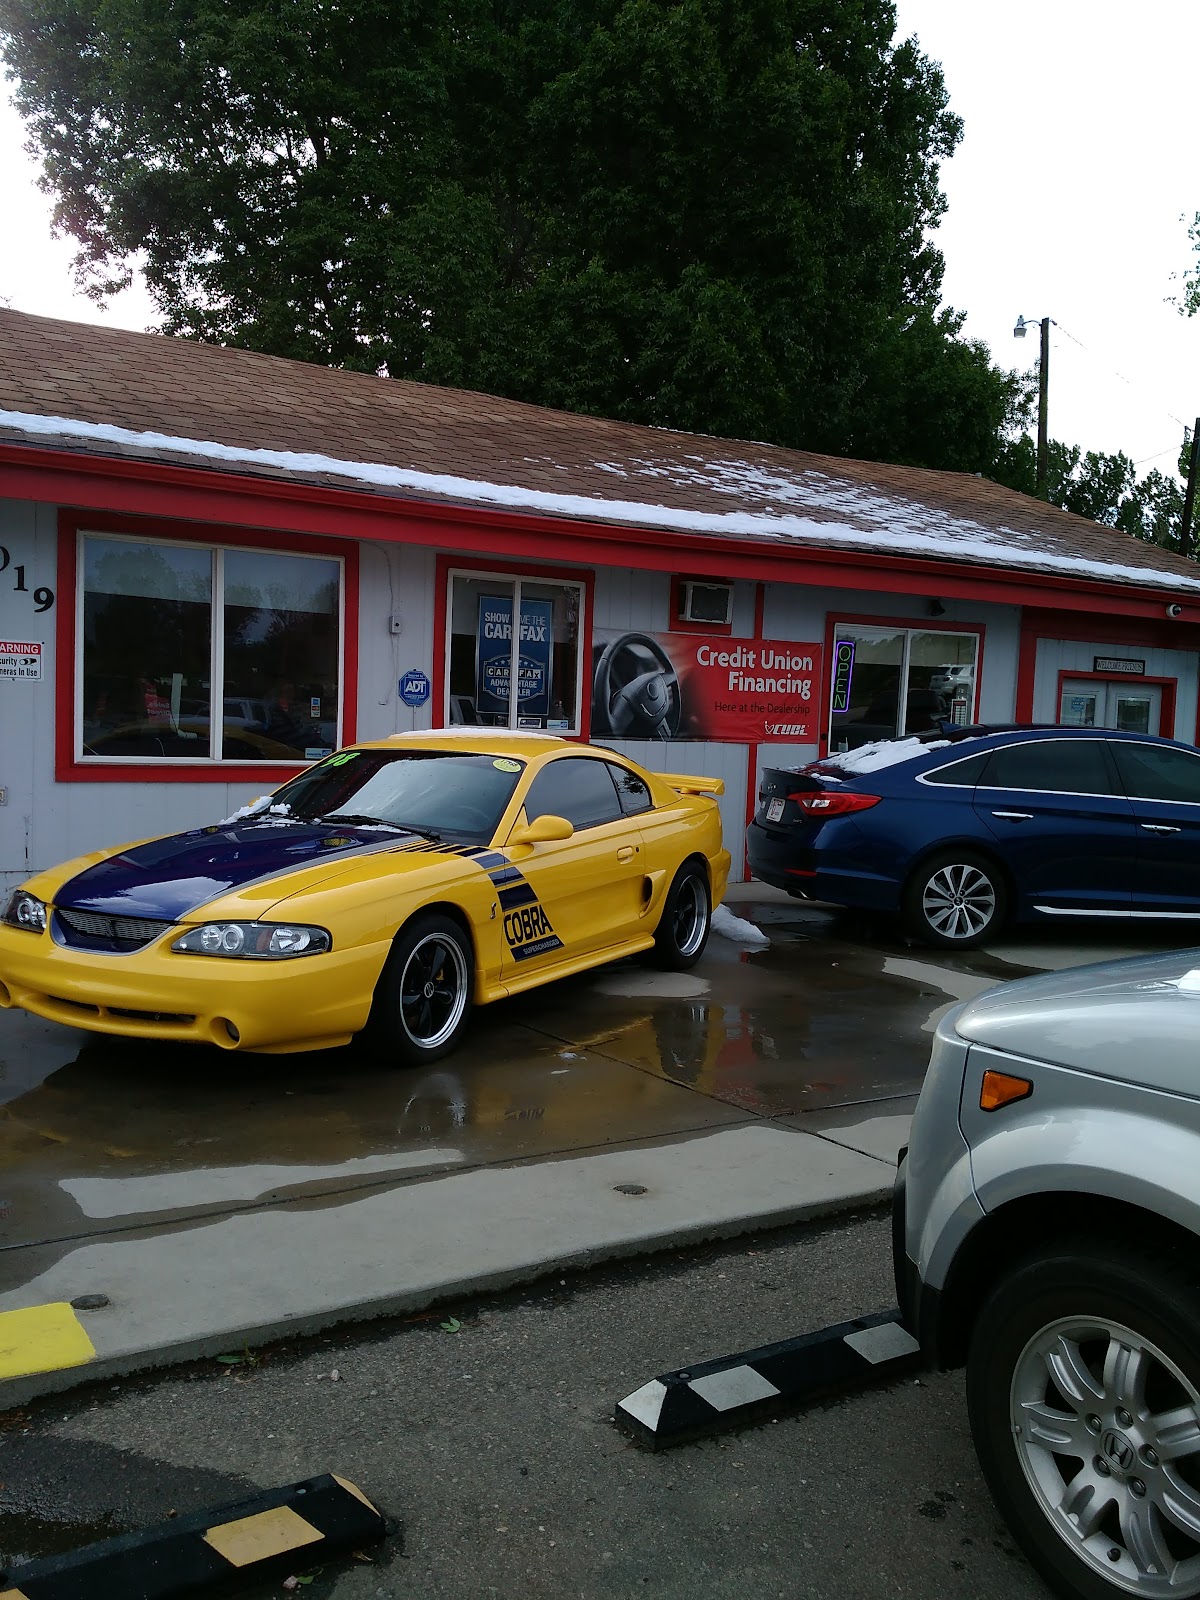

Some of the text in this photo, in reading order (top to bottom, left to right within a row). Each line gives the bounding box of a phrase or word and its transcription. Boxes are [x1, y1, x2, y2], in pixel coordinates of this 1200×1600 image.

[484, 611, 510, 624] SHOW
[531, 615, 546, 627] THE
[0, 643, 39, 654] ARNING
[696, 645, 813, 671] Credit Union
[18, 667, 25, 676] In
[26, 667, 38, 677] Use
[834, 645, 851, 708] OPEN
[405, 680, 427, 693] ADT
[728, 670, 812, 700] Financing
[714, 702, 810, 716] Here at the Dealership
[503, 904, 554, 946] COBRA
